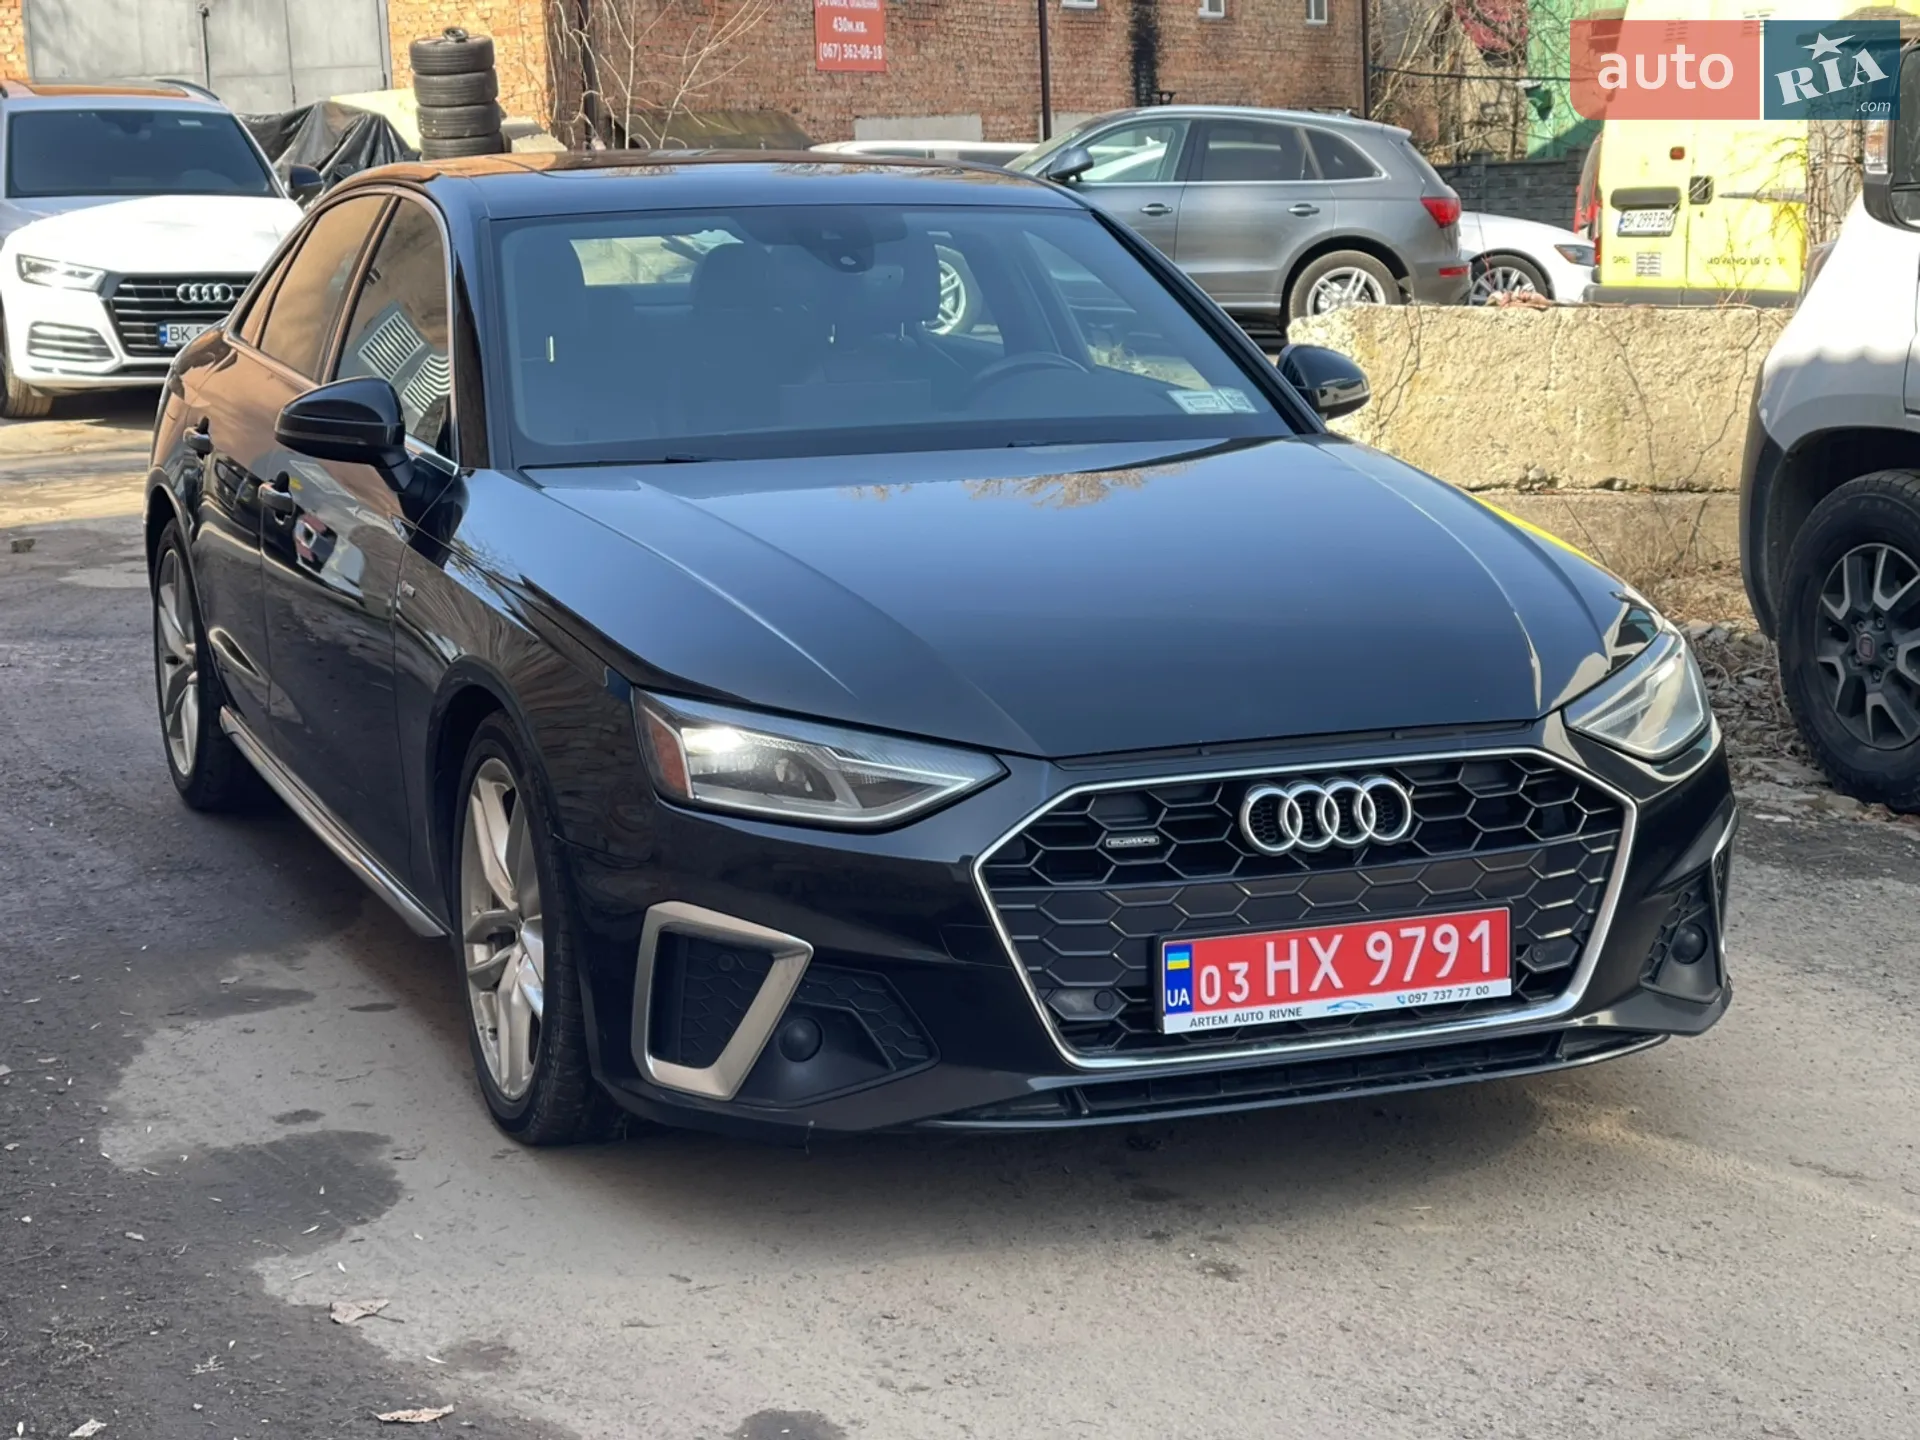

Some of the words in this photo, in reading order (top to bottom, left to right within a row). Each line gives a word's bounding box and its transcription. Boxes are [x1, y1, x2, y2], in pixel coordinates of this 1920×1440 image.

[819, 42, 841, 62] (067)
[1200, 961, 1250, 1005] 03
[1266, 934, 1344, 996] HX
[1365, 919, 1490, 986] 9791
[1167, 988, 1190, 1007] UA
[1408, 992, 1428, 1004] 097
[1433, 989, 1452, 1001] 737
[1458, 987, 1471, 998] 77
[1475, 985, 1490, 996] 00
[1189, 1014, 1228, 1028] ARTEM
[1233, 1010, 1264, 1023] AUTO
[1269, 1007, 1303, 1020] RIVNE
